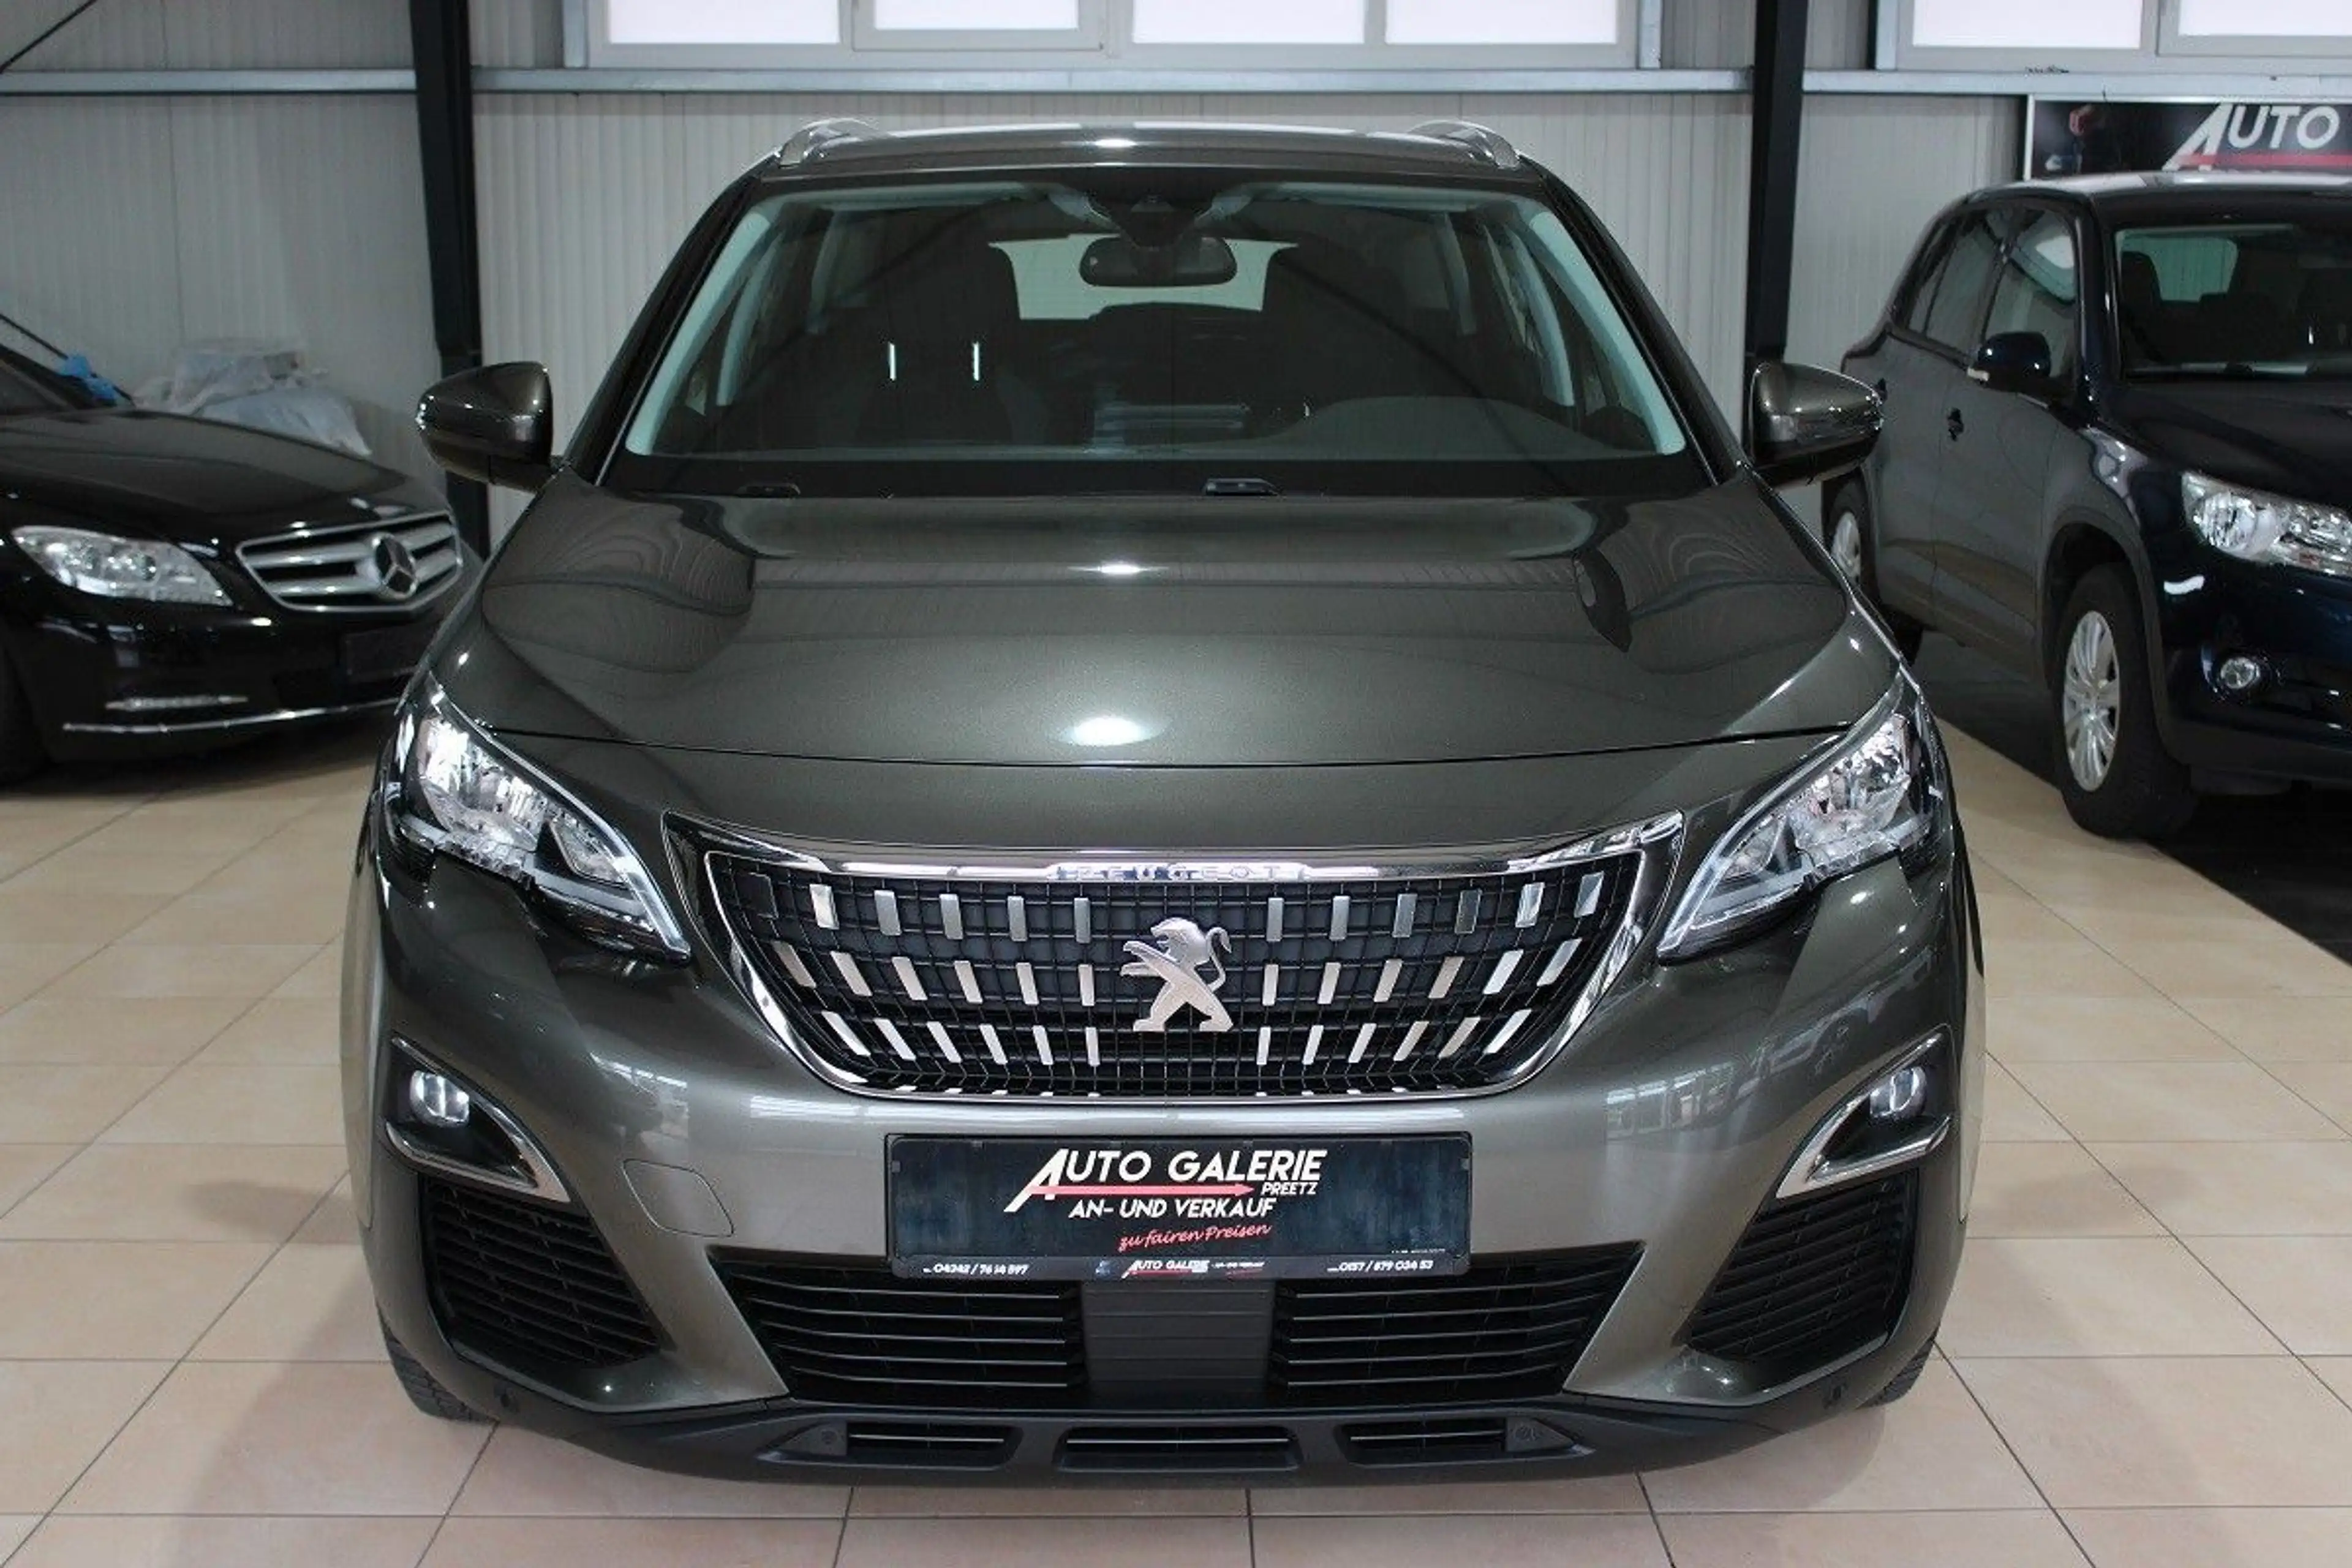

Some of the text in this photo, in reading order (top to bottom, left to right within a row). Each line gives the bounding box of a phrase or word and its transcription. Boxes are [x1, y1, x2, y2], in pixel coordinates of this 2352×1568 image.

[2162, 102, 2340, 171] AUTO
[1004, 1148, 1328, 1212] AUTO GALERIE
[1261, 1182, 1317, 1196] PREETZ
[1068, 1197, 1276, 1218] AN- UND VERKAUF
